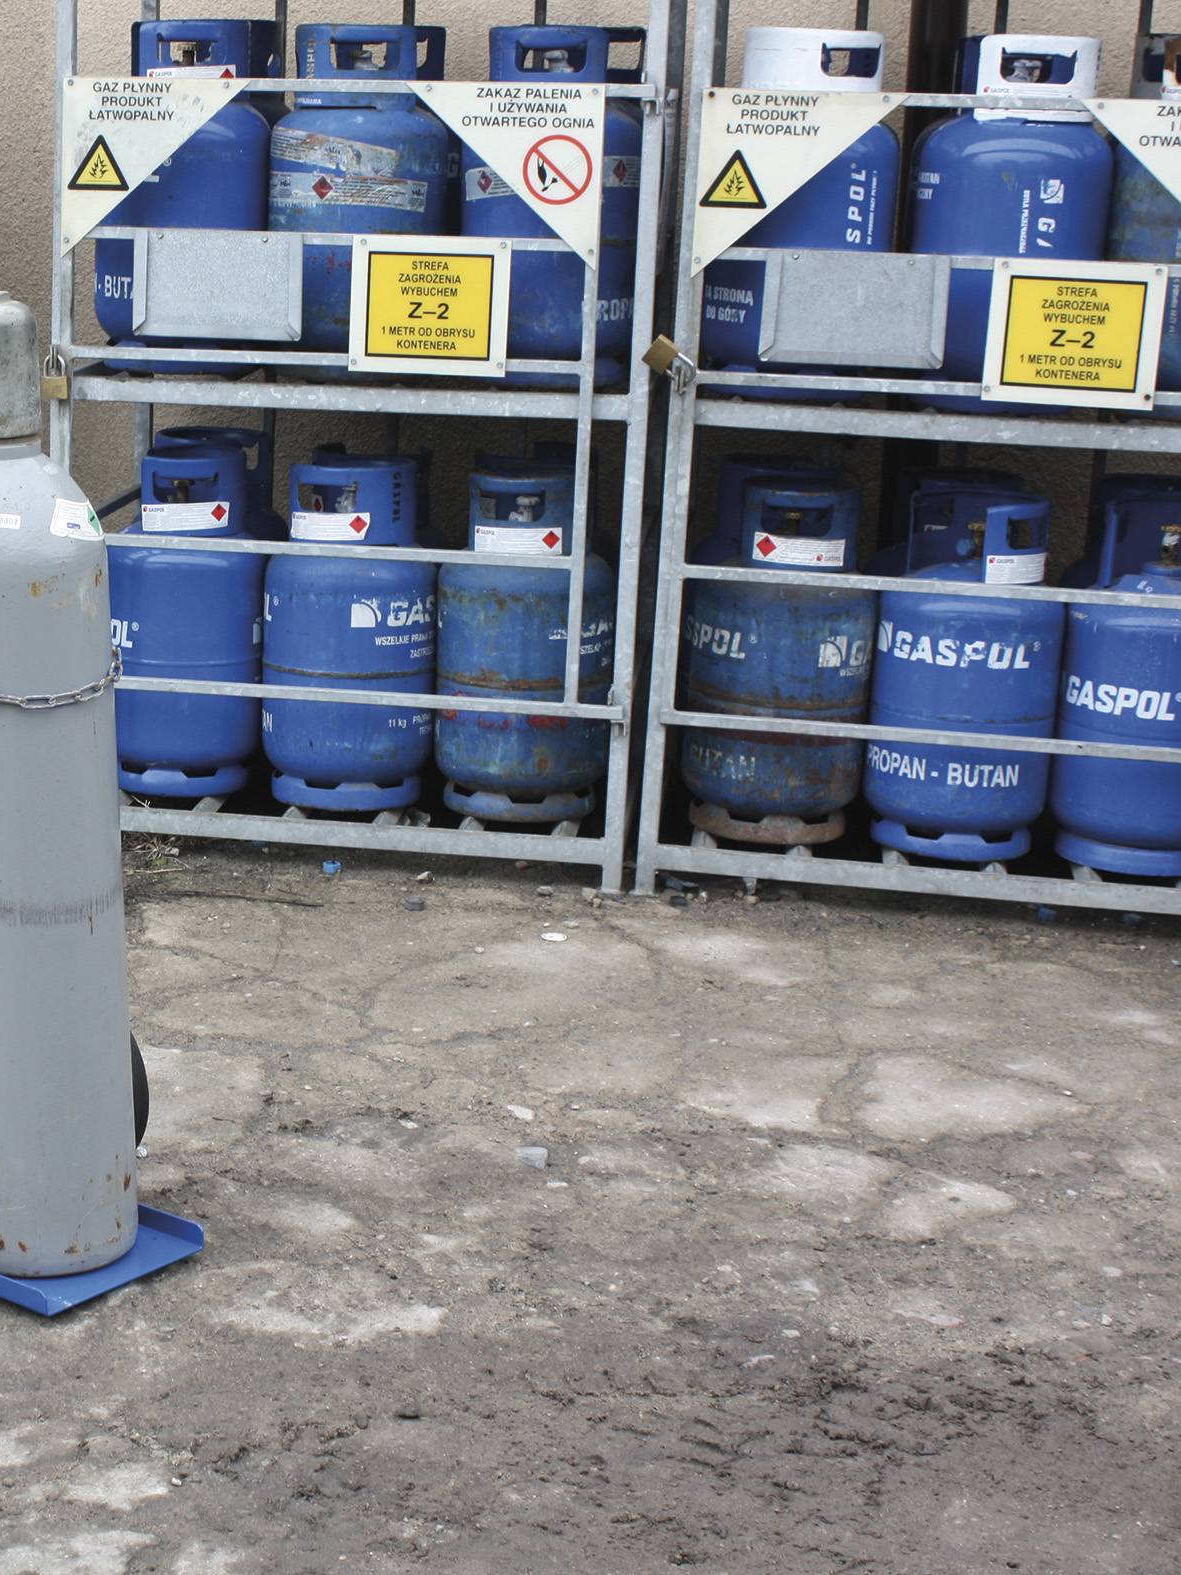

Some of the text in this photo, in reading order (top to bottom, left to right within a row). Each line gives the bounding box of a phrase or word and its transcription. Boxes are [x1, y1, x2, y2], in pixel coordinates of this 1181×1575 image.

[93, 82, 172, 93] GAZ PŁYNNY
[476, 88, 582, 99] ZAKAZ PALENIA
[101, 96, 163, 107] PRODUKT
[490, 99, 567, 113] I UŻYWANIA
[732, 94, 819, 107] GAZ PŁYNNY
[89, 110, 174, 121] ŁATWOPALNY
[741, 109, 809, 120] PRODUKT
[461, 116, 595, 128] OTWARTEGO OGNIA
[726, 123, 820, 136] ŁATWOPALNY
[412, 261, 449, 271] STREFA
[401, 287, 458, 297] WYBUCHEM
[1057, 286, 1097, 297] STREFA
[1044, 313, 1105, 325] WYBUCHEM
[382, 326, 476, 338] 1 METR OD OBRYSU
[397, 340, 457, 351] KONTENERA
[1020, 354, 1122, 369] 1 METR OD OBRYSU
[1035, 368, 1100, 381] KONTENERA
[374, 634, 410, 646] WSZELKIE
[893, 630, 1031, 670] GASPOL
[1066, 675, 1175, 721] GASPOL
[388, 718, 407, 729] 11 kg
[868, 743, 926, 781] PROPAN
[947, 762, 1020, 788] BUTAN
